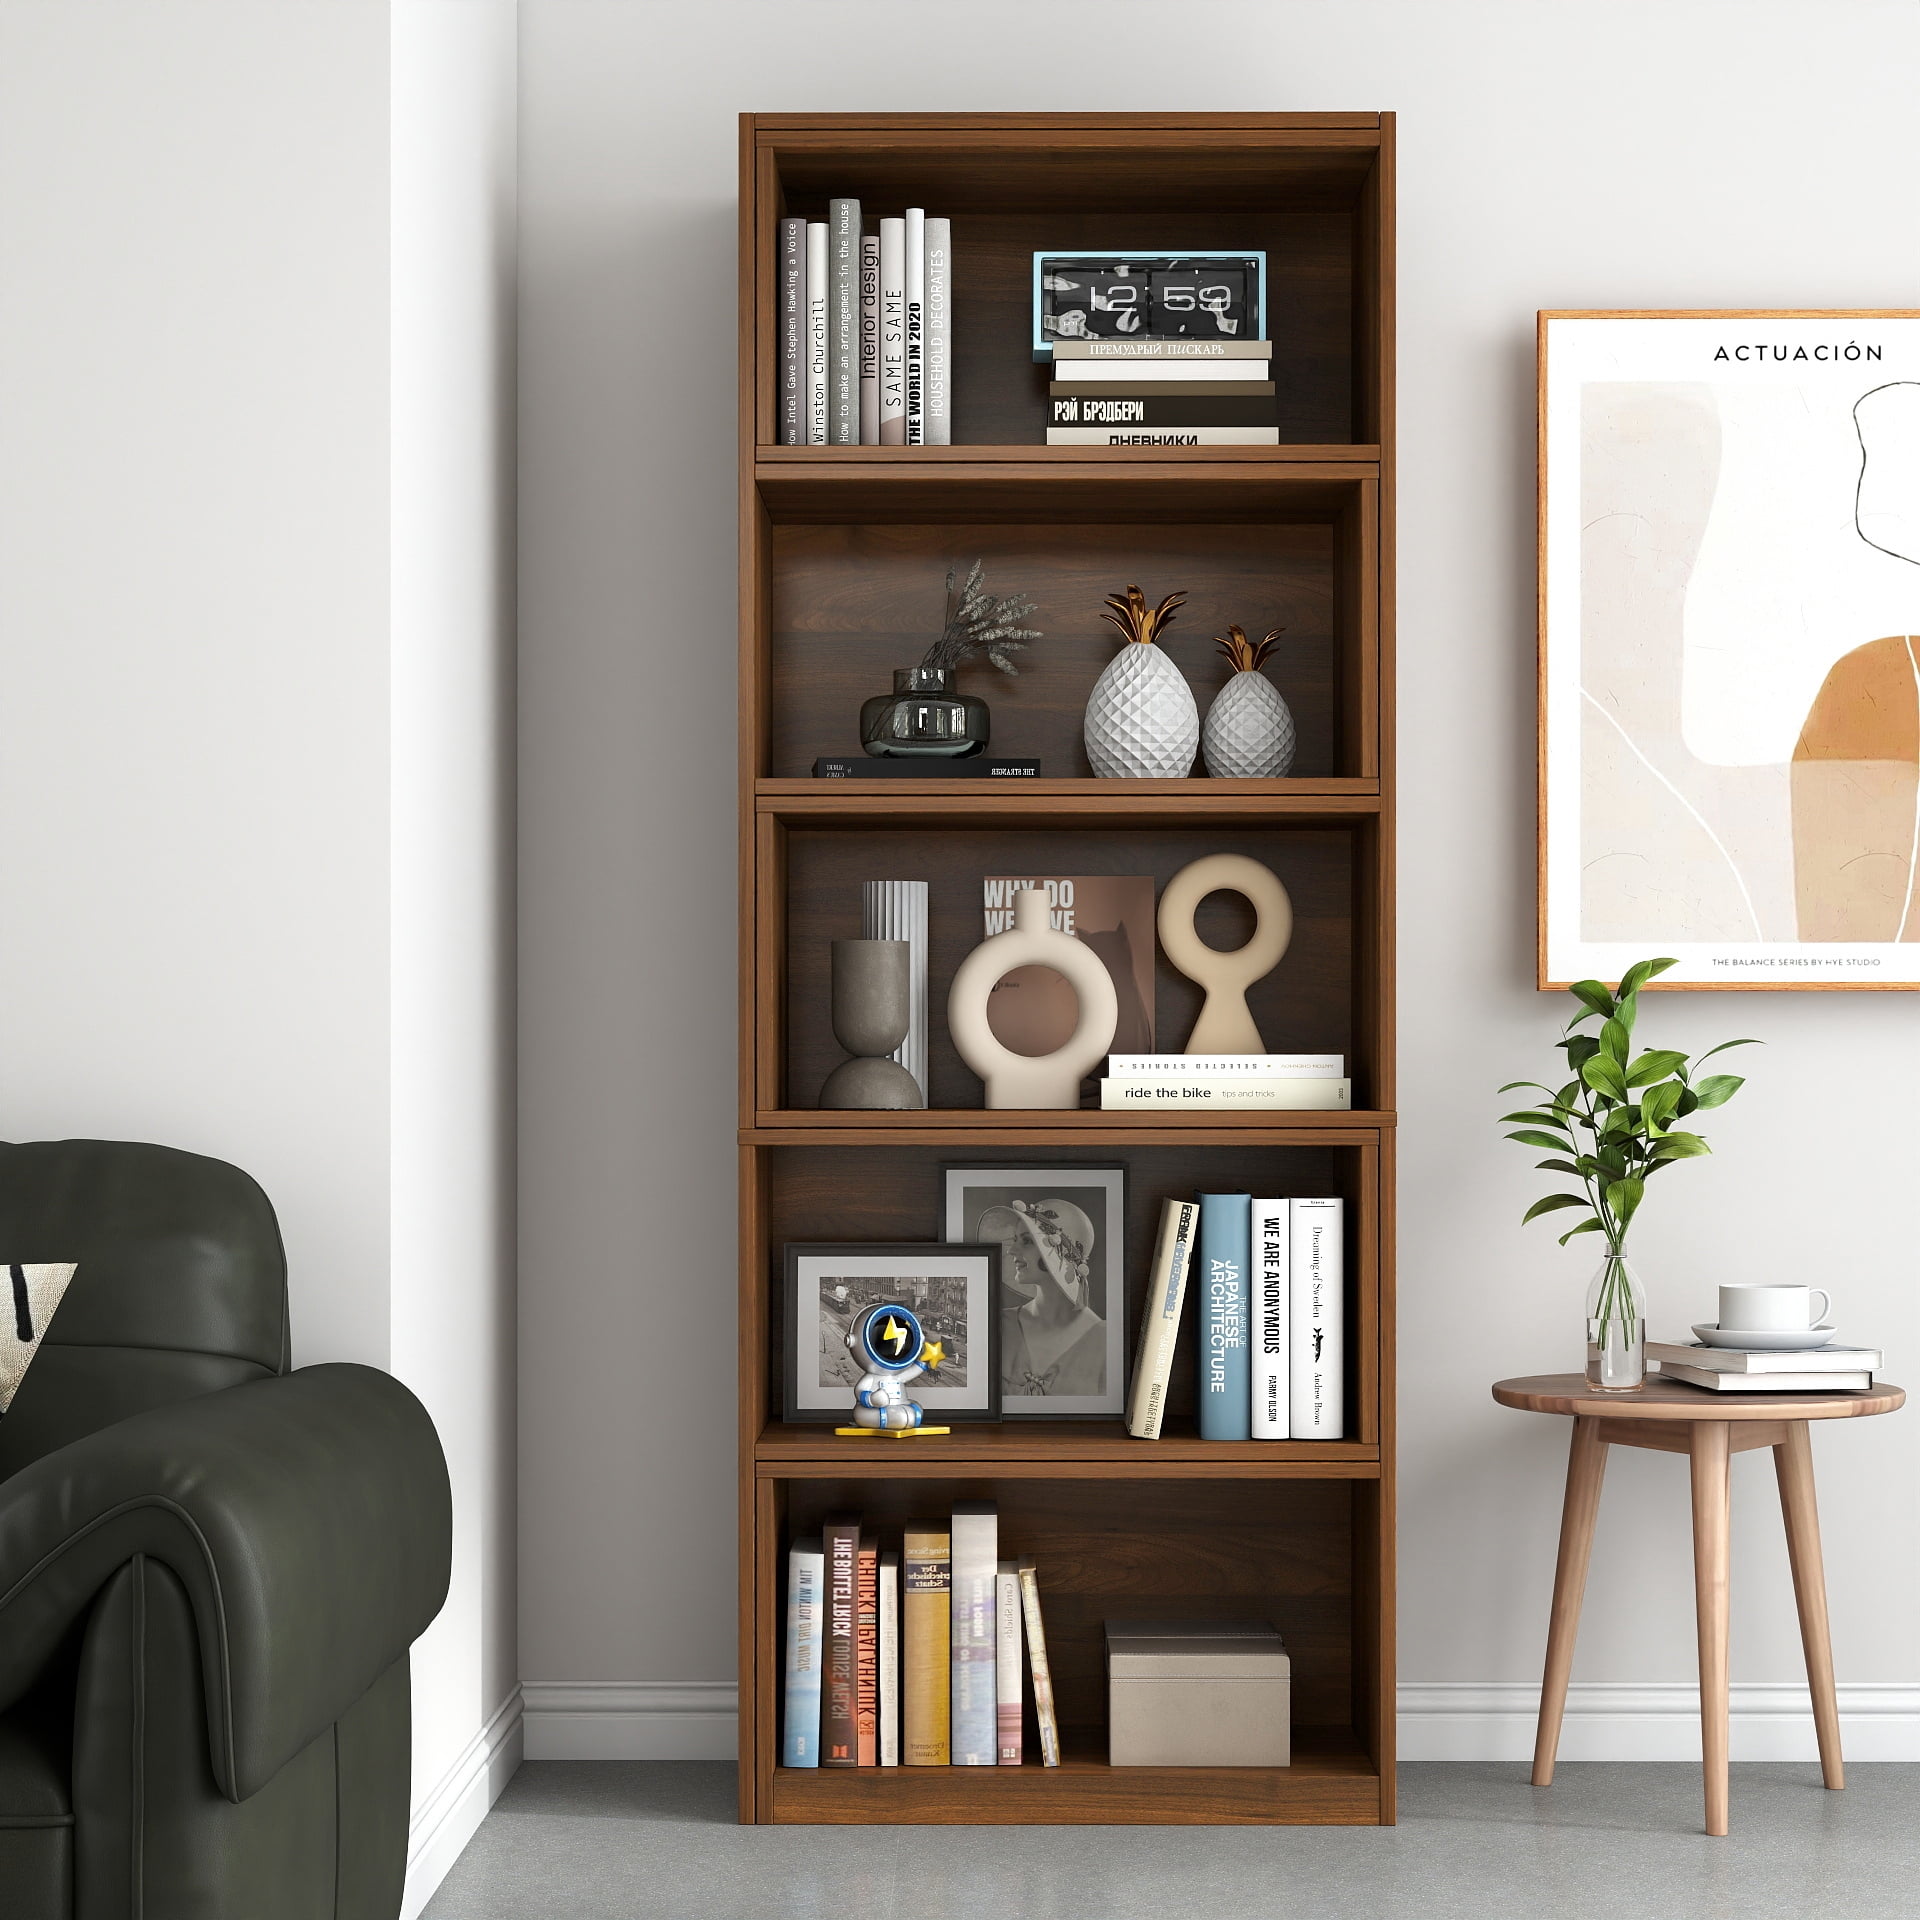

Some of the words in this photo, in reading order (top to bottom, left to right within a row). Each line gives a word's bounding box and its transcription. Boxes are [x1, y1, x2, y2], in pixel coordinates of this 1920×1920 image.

[839, 204, 849, 234] house
[787, 224, 796, 253] Voice
[839, 241, 849, 258] the
[839, 265, 849, 276] in
[861, 243, 878, 306] design
[787, 271, 798, 312] Hawking
[930, 249, 944, 328] DECORATES
[1090, 286, 1137, 312] 12
[1163, 286, 1231, 312] 59
[840, 283, 850, 349] arrangement
[886, 290, 901, 342] SAME
[909, 302, 921, 340] 2020
[787, 318, 798, 358] Stephen
[813, 298, 824, 374] Churchill
[861, 313, 876, 379] Interior
[1090, 343, 1161, 355] ПРЕМУДРЫЙ
[1167, 344, 1224, 355] ПИСКАРЬ
[841, 357, 849, 368] an
[909, 345, 921, 359] IN
[1714, 340, 1881, 361] ACTUACIÓN
[788, 365, 796, 388] Gave
[839, 375, 849, 398] make
[886, 354, 901, 406] SAME
[909, 364, 921, 415] WORLD
[930, 338, 944, 416] HOUSEHOLD
[787, 395, 796, 423] Intel
[813, 383, 824, 442] Winston
[840, 405, 849, 416] to
[1055, 397, 1078, 421] РЭЙ
[1084, 401, 1144, 422] БРЭДБЕРИ
[840, 422, 849, 442] How
[909, 420, 921, 445] THE
[1044, 880, 1074, 908] DO
[1125, 1088, 1151, 1098] ride
[1156, 1088, 1178, 1098] the
[1183, 1088, 1211, 1098] bike
[1222, 1090, 1236, 1098] tips
[1264, 1218, 1279, 1238] WE
[1264, 1241, 1279, 1267] ARE
[1309, 1227, 1322, 1270] Dreaming
[1312, 1272, 1323, 1283] of
[1225, 1260, 1239, 1348] JAPANESE
[1239, 1297, 1247, 1313] THE
[1264, 1272, 1279, 1354] ANONYMOUS
[1312, 1285, 1324, 1318] Sweden
[1211, 1260, 1225, 1393] ARCHITECTURE
[1239, 1315, 1247, 1331] ART
[1239, 1334, 1247, 1347] OF
[1268, 1375, 1277, 1399] PARMY
[1314, 1373, 1322, 1400] Andrew
[1268, 1401, 1277, 1422] OLSON
[1314, 1404, 1322, 1426] Brown
